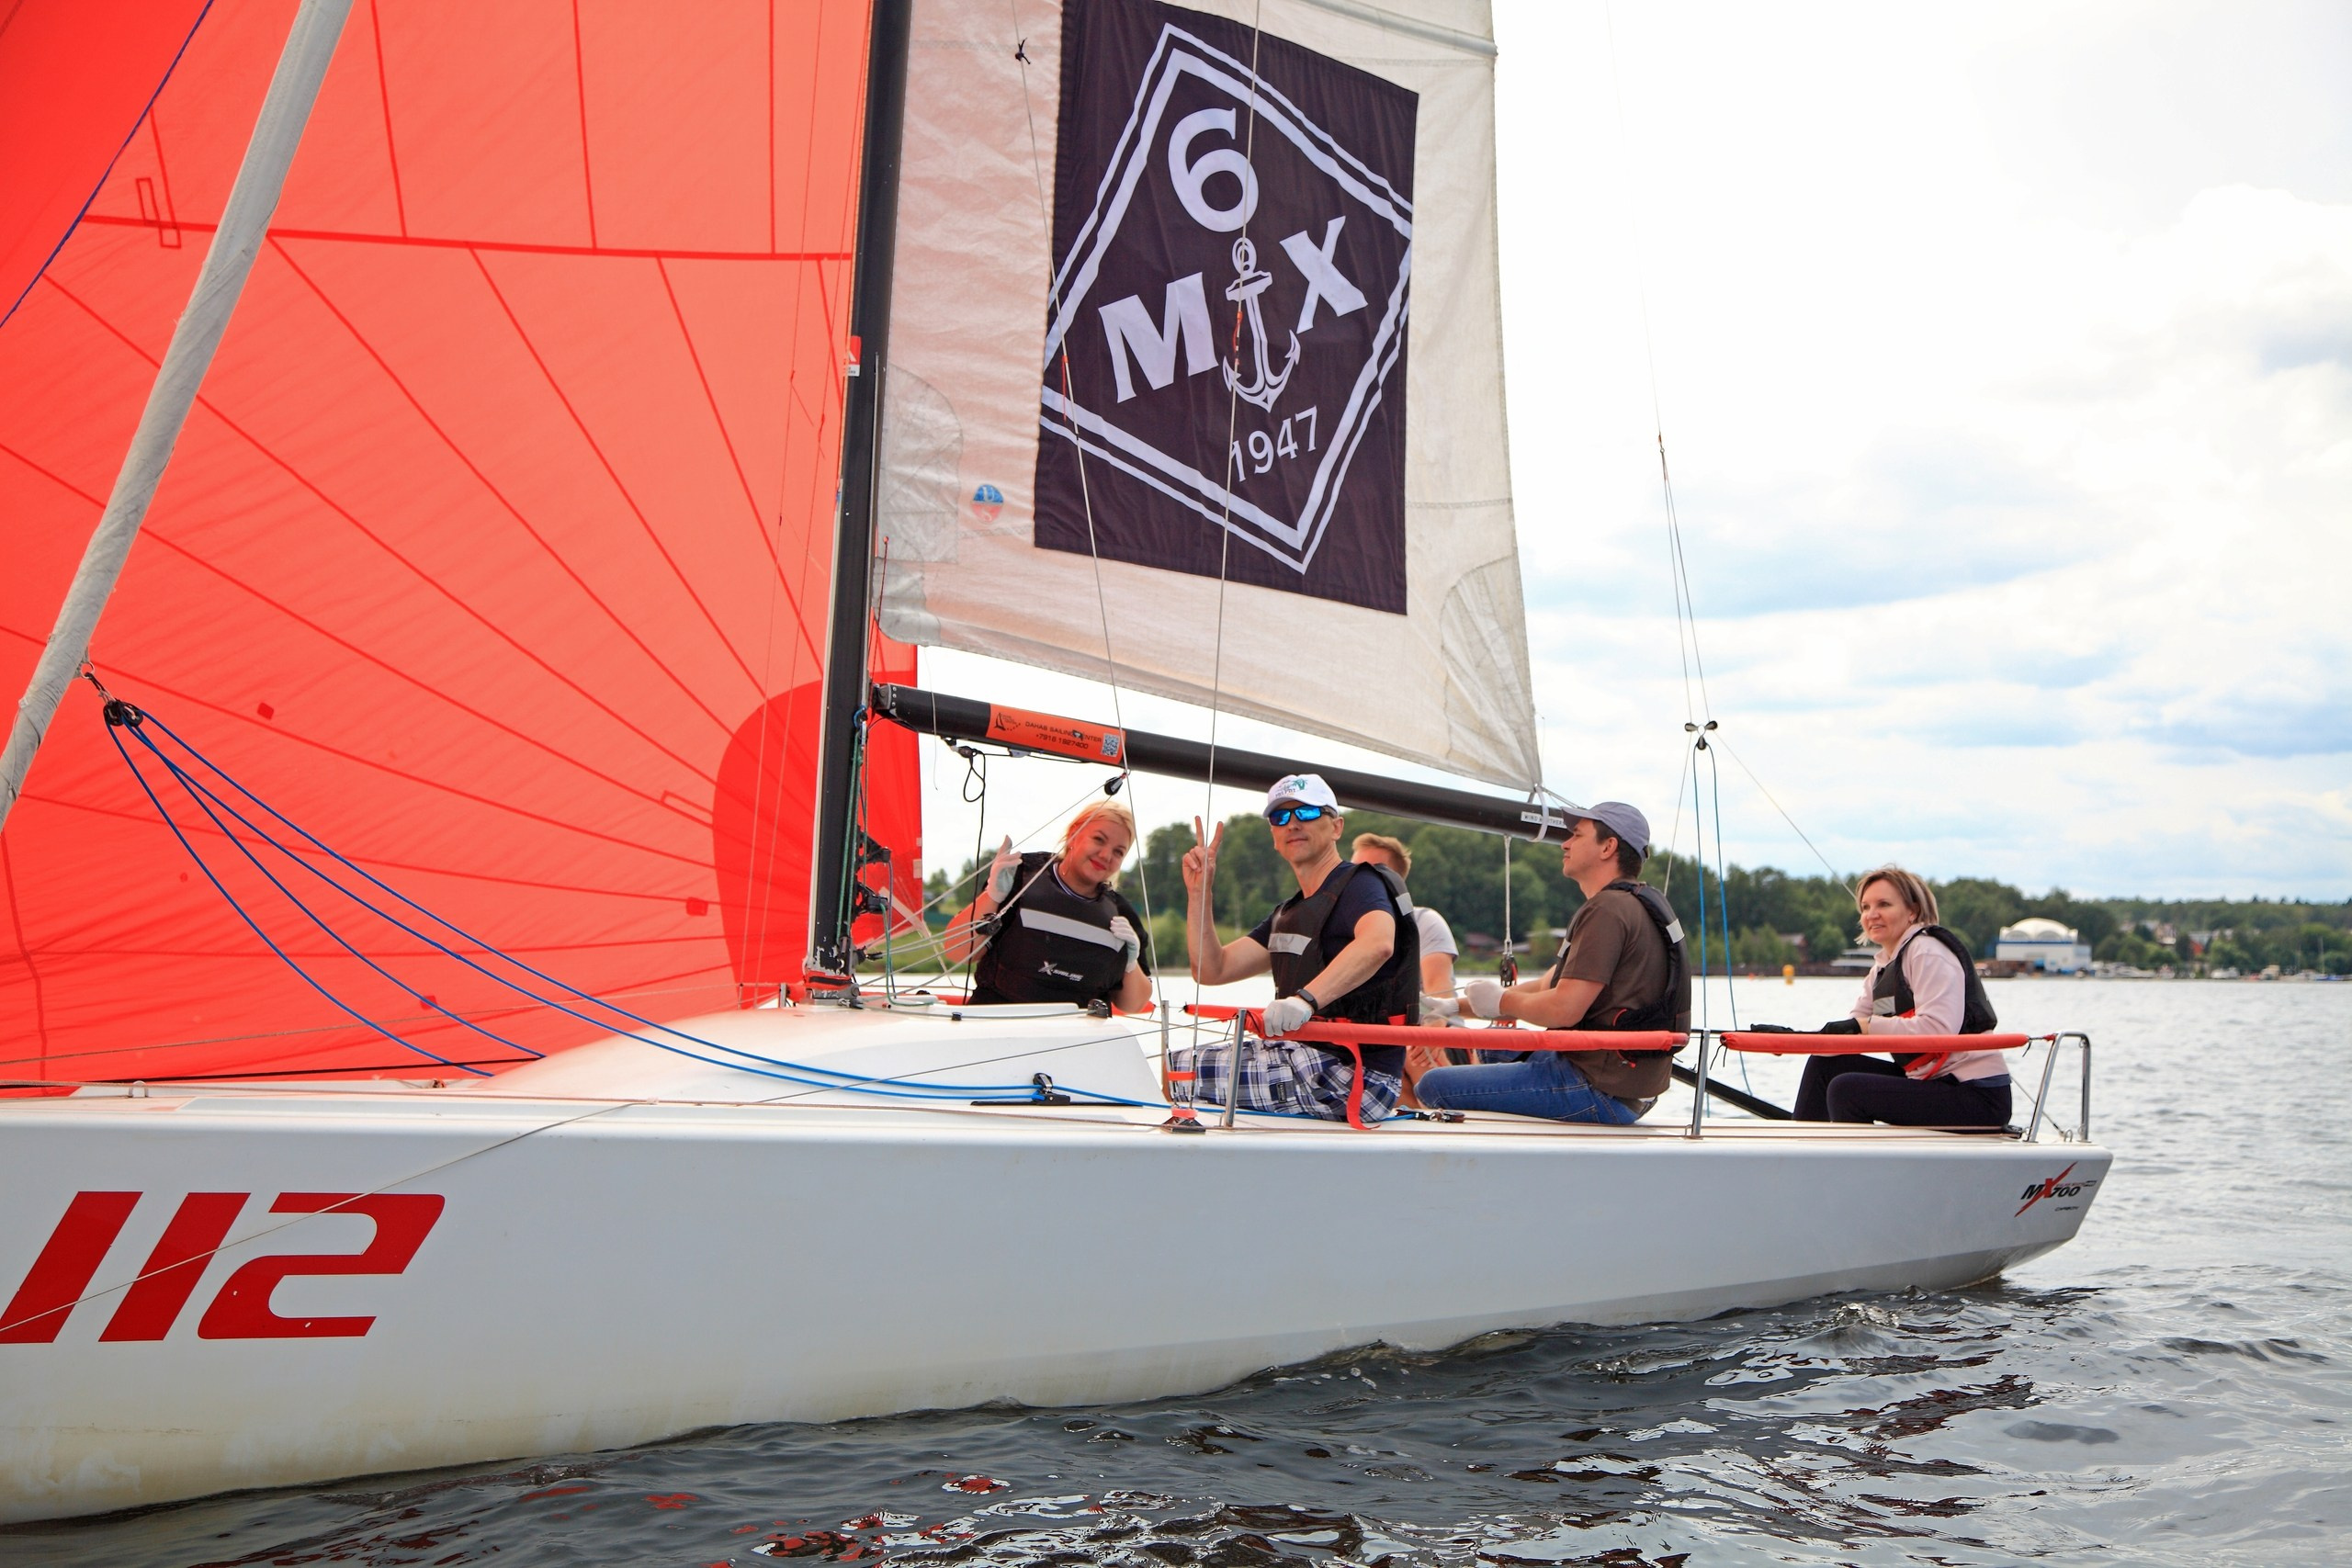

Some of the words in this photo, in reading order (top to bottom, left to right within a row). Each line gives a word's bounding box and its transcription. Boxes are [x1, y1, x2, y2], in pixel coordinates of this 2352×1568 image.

[1168, 107, 1259, 232] 6
[1230, 405, 1317, 482] 1947
[0, 1191, 446, 1344] 112
